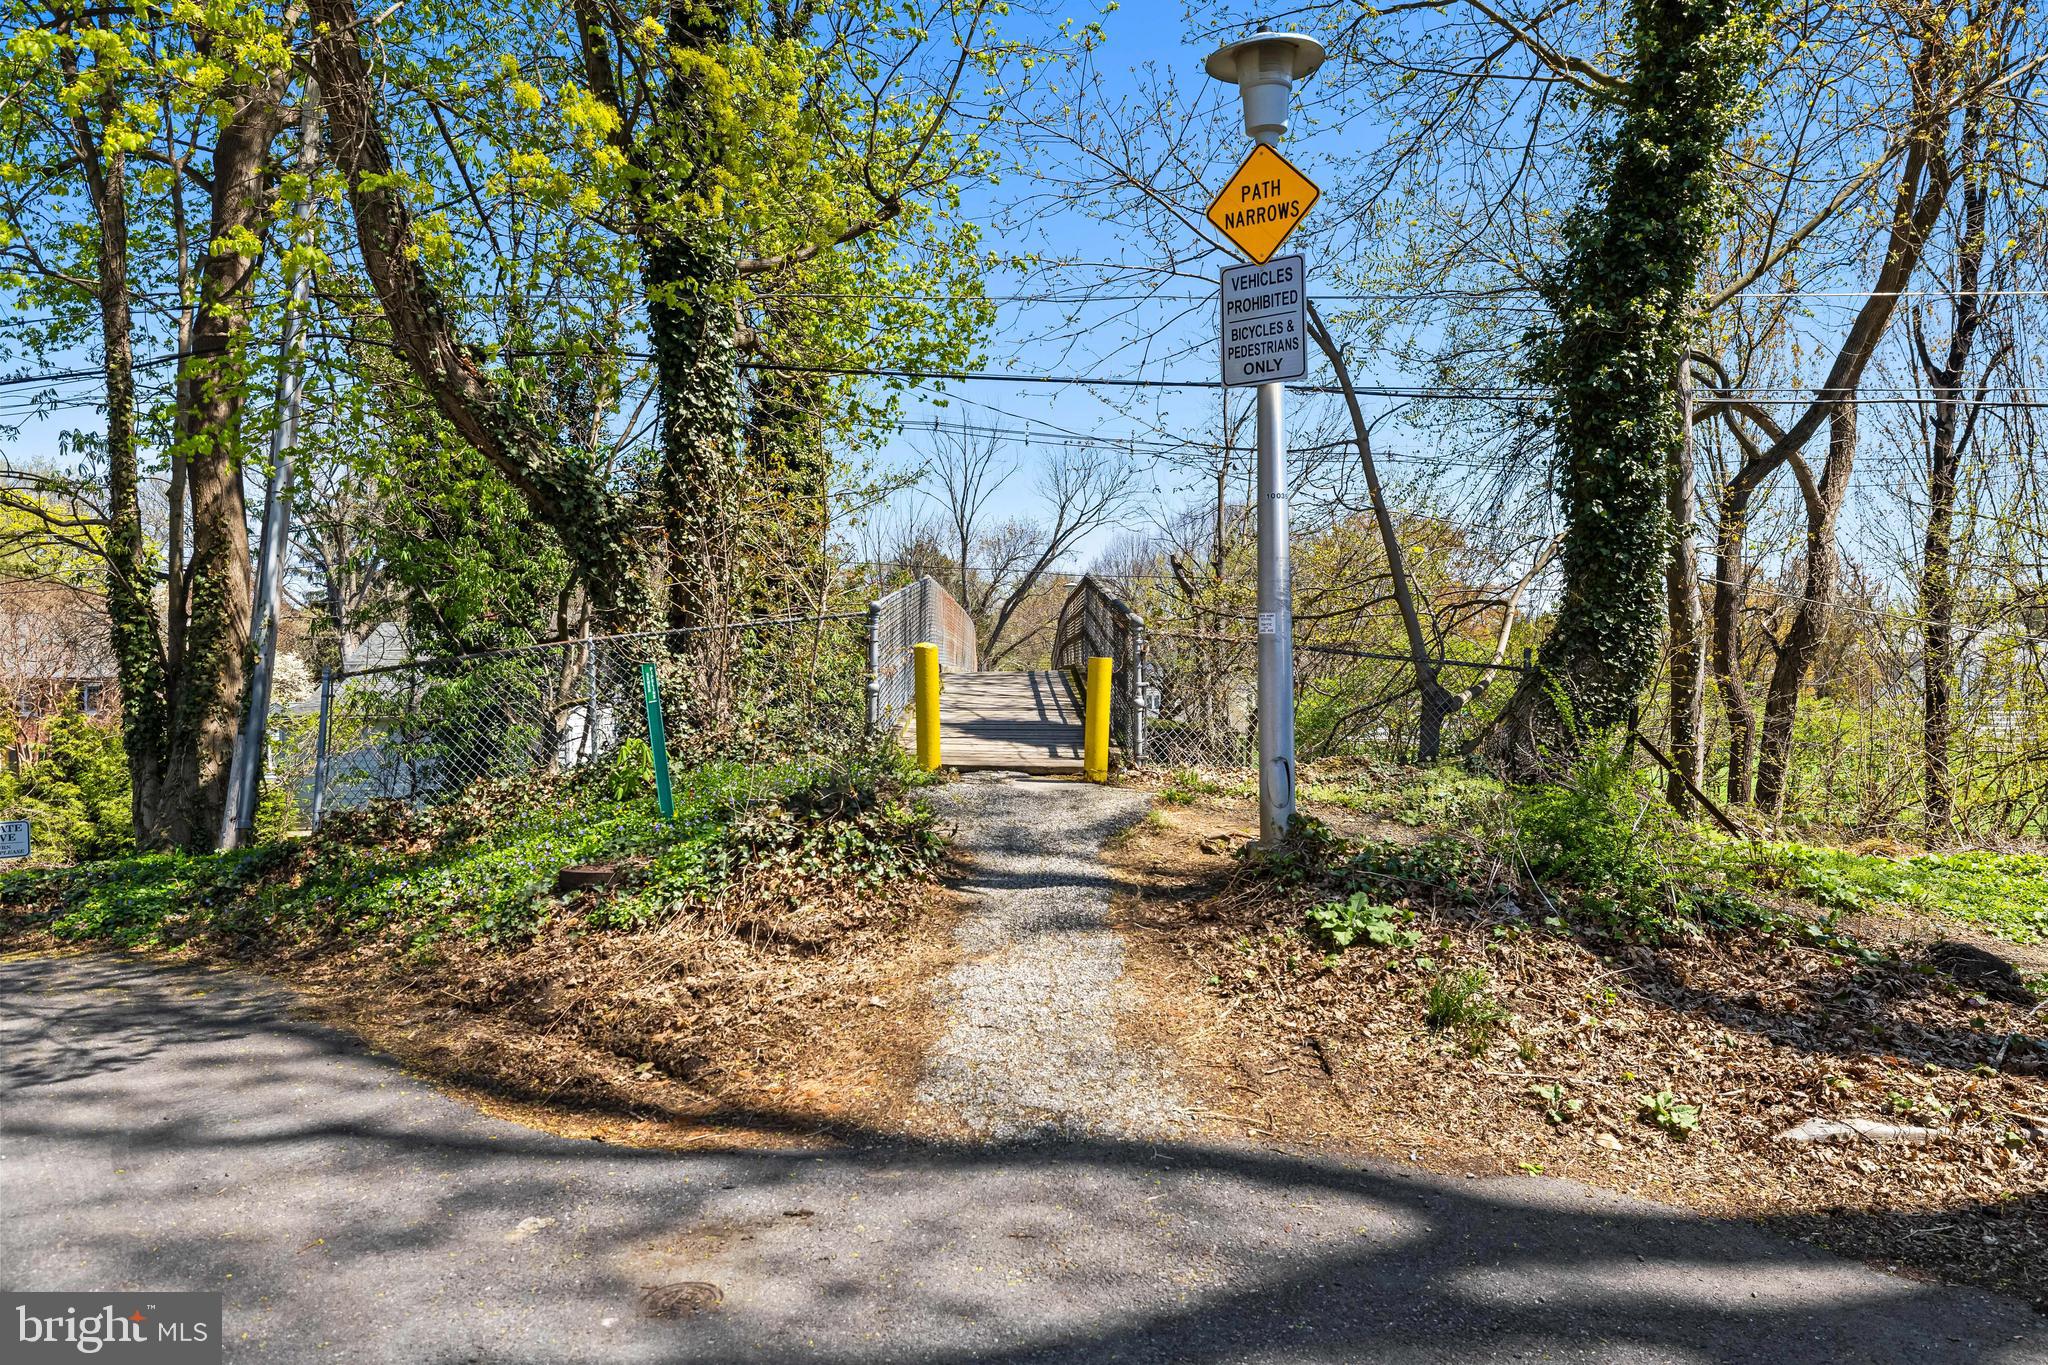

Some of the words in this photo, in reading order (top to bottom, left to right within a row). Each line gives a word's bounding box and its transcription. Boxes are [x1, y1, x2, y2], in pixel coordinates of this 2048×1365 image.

[1241, 179, 1281, 203] PATH
[1225, 200, 1300, 230] NARROWS
[1231, 267, 1293, 291] VEHICLES
[1227, 290, 1298, 316] PROHIBITED
[1231, 321, 1284, 341] BICYCLES
[1286, 319, 1295, 333] &
[1228, 337, 1299, 360] PEDESTRIANS
[1243, 358, 1283, 375] ONLY
